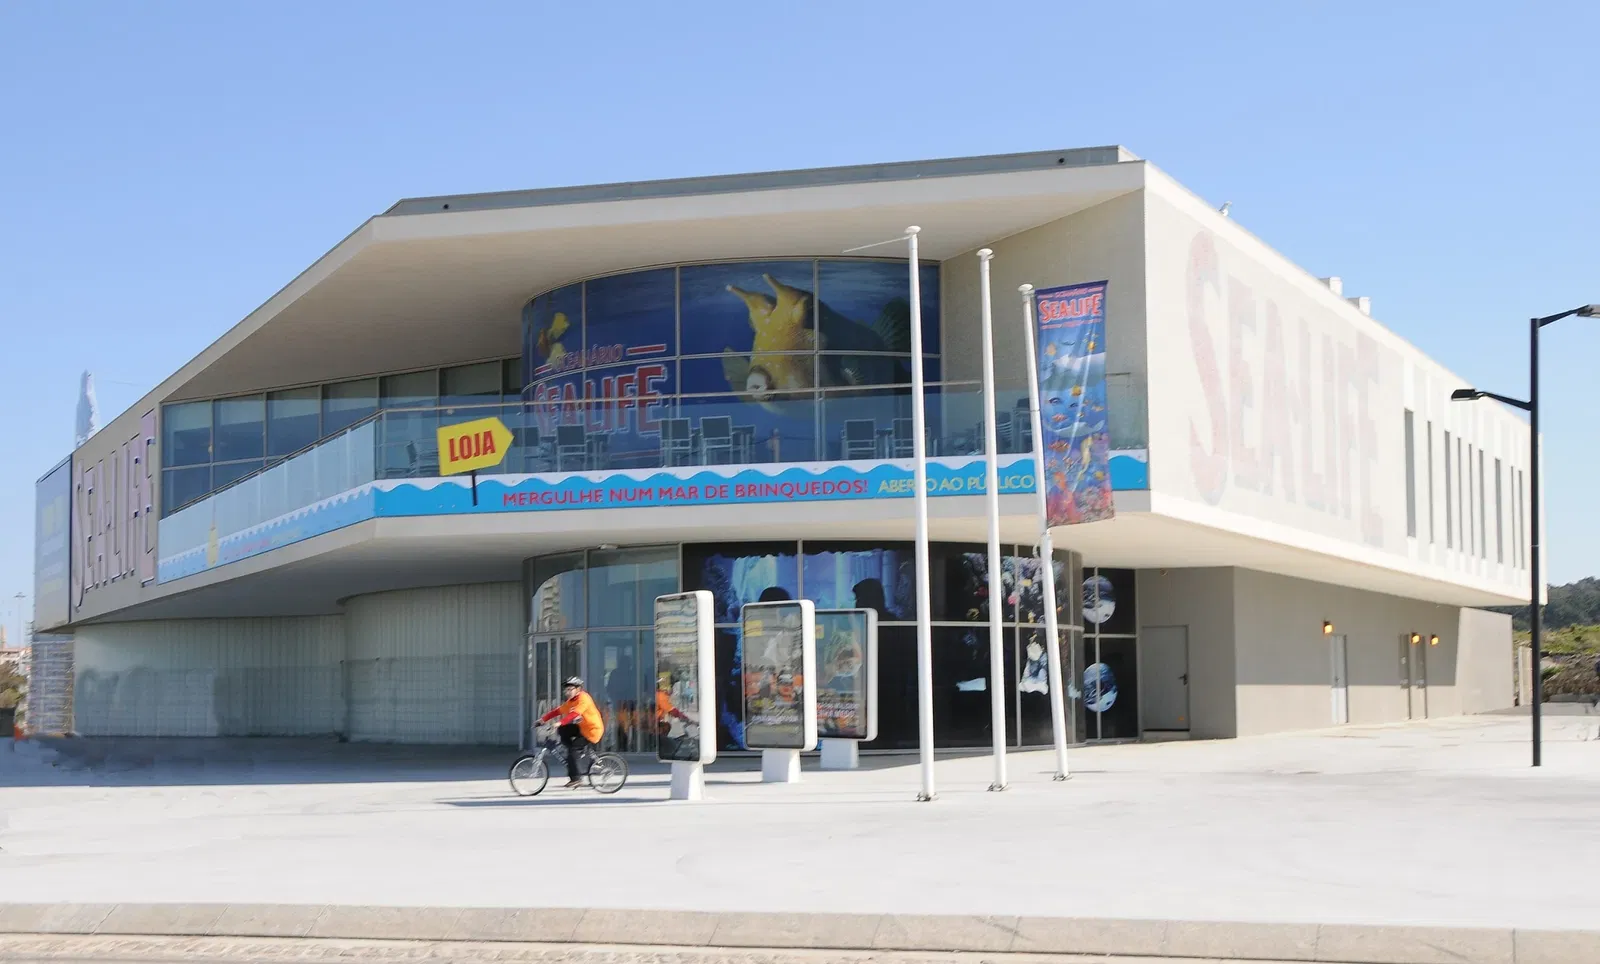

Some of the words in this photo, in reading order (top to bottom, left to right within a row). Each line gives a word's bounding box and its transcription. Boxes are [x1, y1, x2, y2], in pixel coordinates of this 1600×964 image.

[448, 429, 496, 463] LOJA
[503, 488, 604, 507] MERGULHE
[609, 486, 653, 502] NUM
[659, 485, 698, 500] MAR
[705, 484, 729, 499] DE
[735, 479, 869, 499] BRINQUEDOS!
[877, 477, 938, 494] ABERO
[938, 476, 965, 492] AO
[967, 472, 1035, 490] PÚLICO
